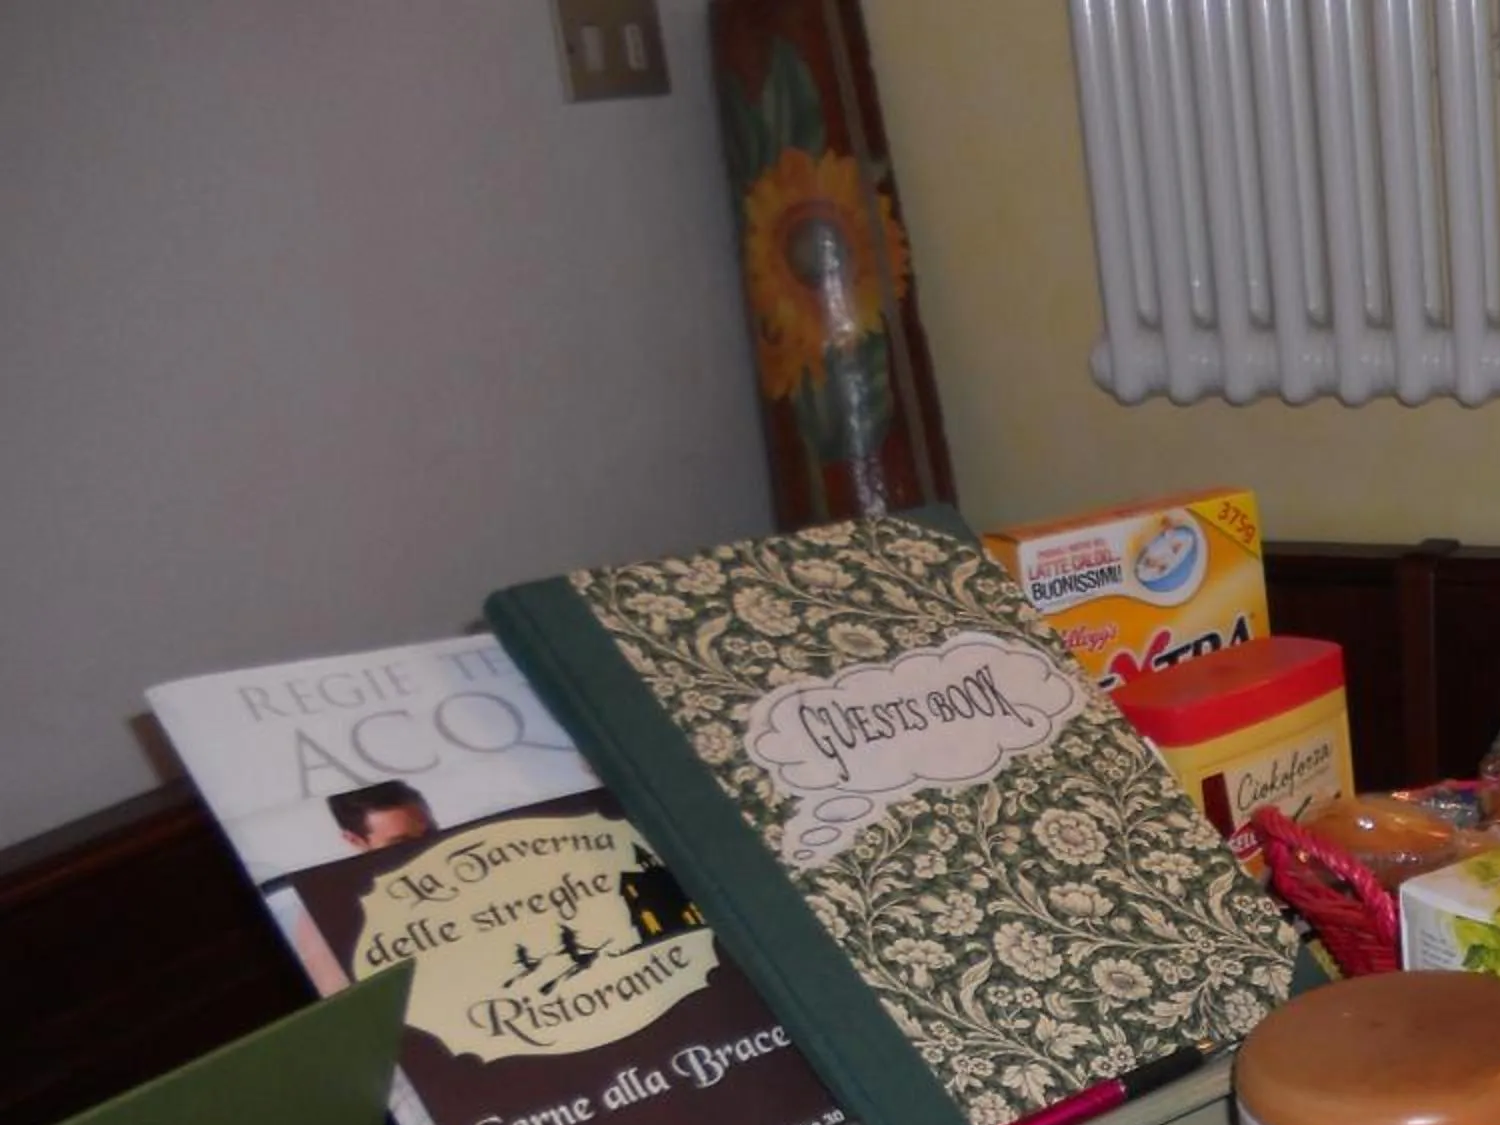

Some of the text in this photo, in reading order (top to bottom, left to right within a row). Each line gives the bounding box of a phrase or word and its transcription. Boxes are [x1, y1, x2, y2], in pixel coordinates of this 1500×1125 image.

[1216, 501, 1257, 544] 375g
[238, 663, 412, 724] REGIE
[927, 665, 1034, 728] BOOK
[386, 830, 616, 907] La Taverna
[365, 872, 614, 968] delle streghe
[467, 943, 691, 1047] Ristorante
[602, 1062, 672, 1112] alla
[671, 1024, 792, 1090] Brace
